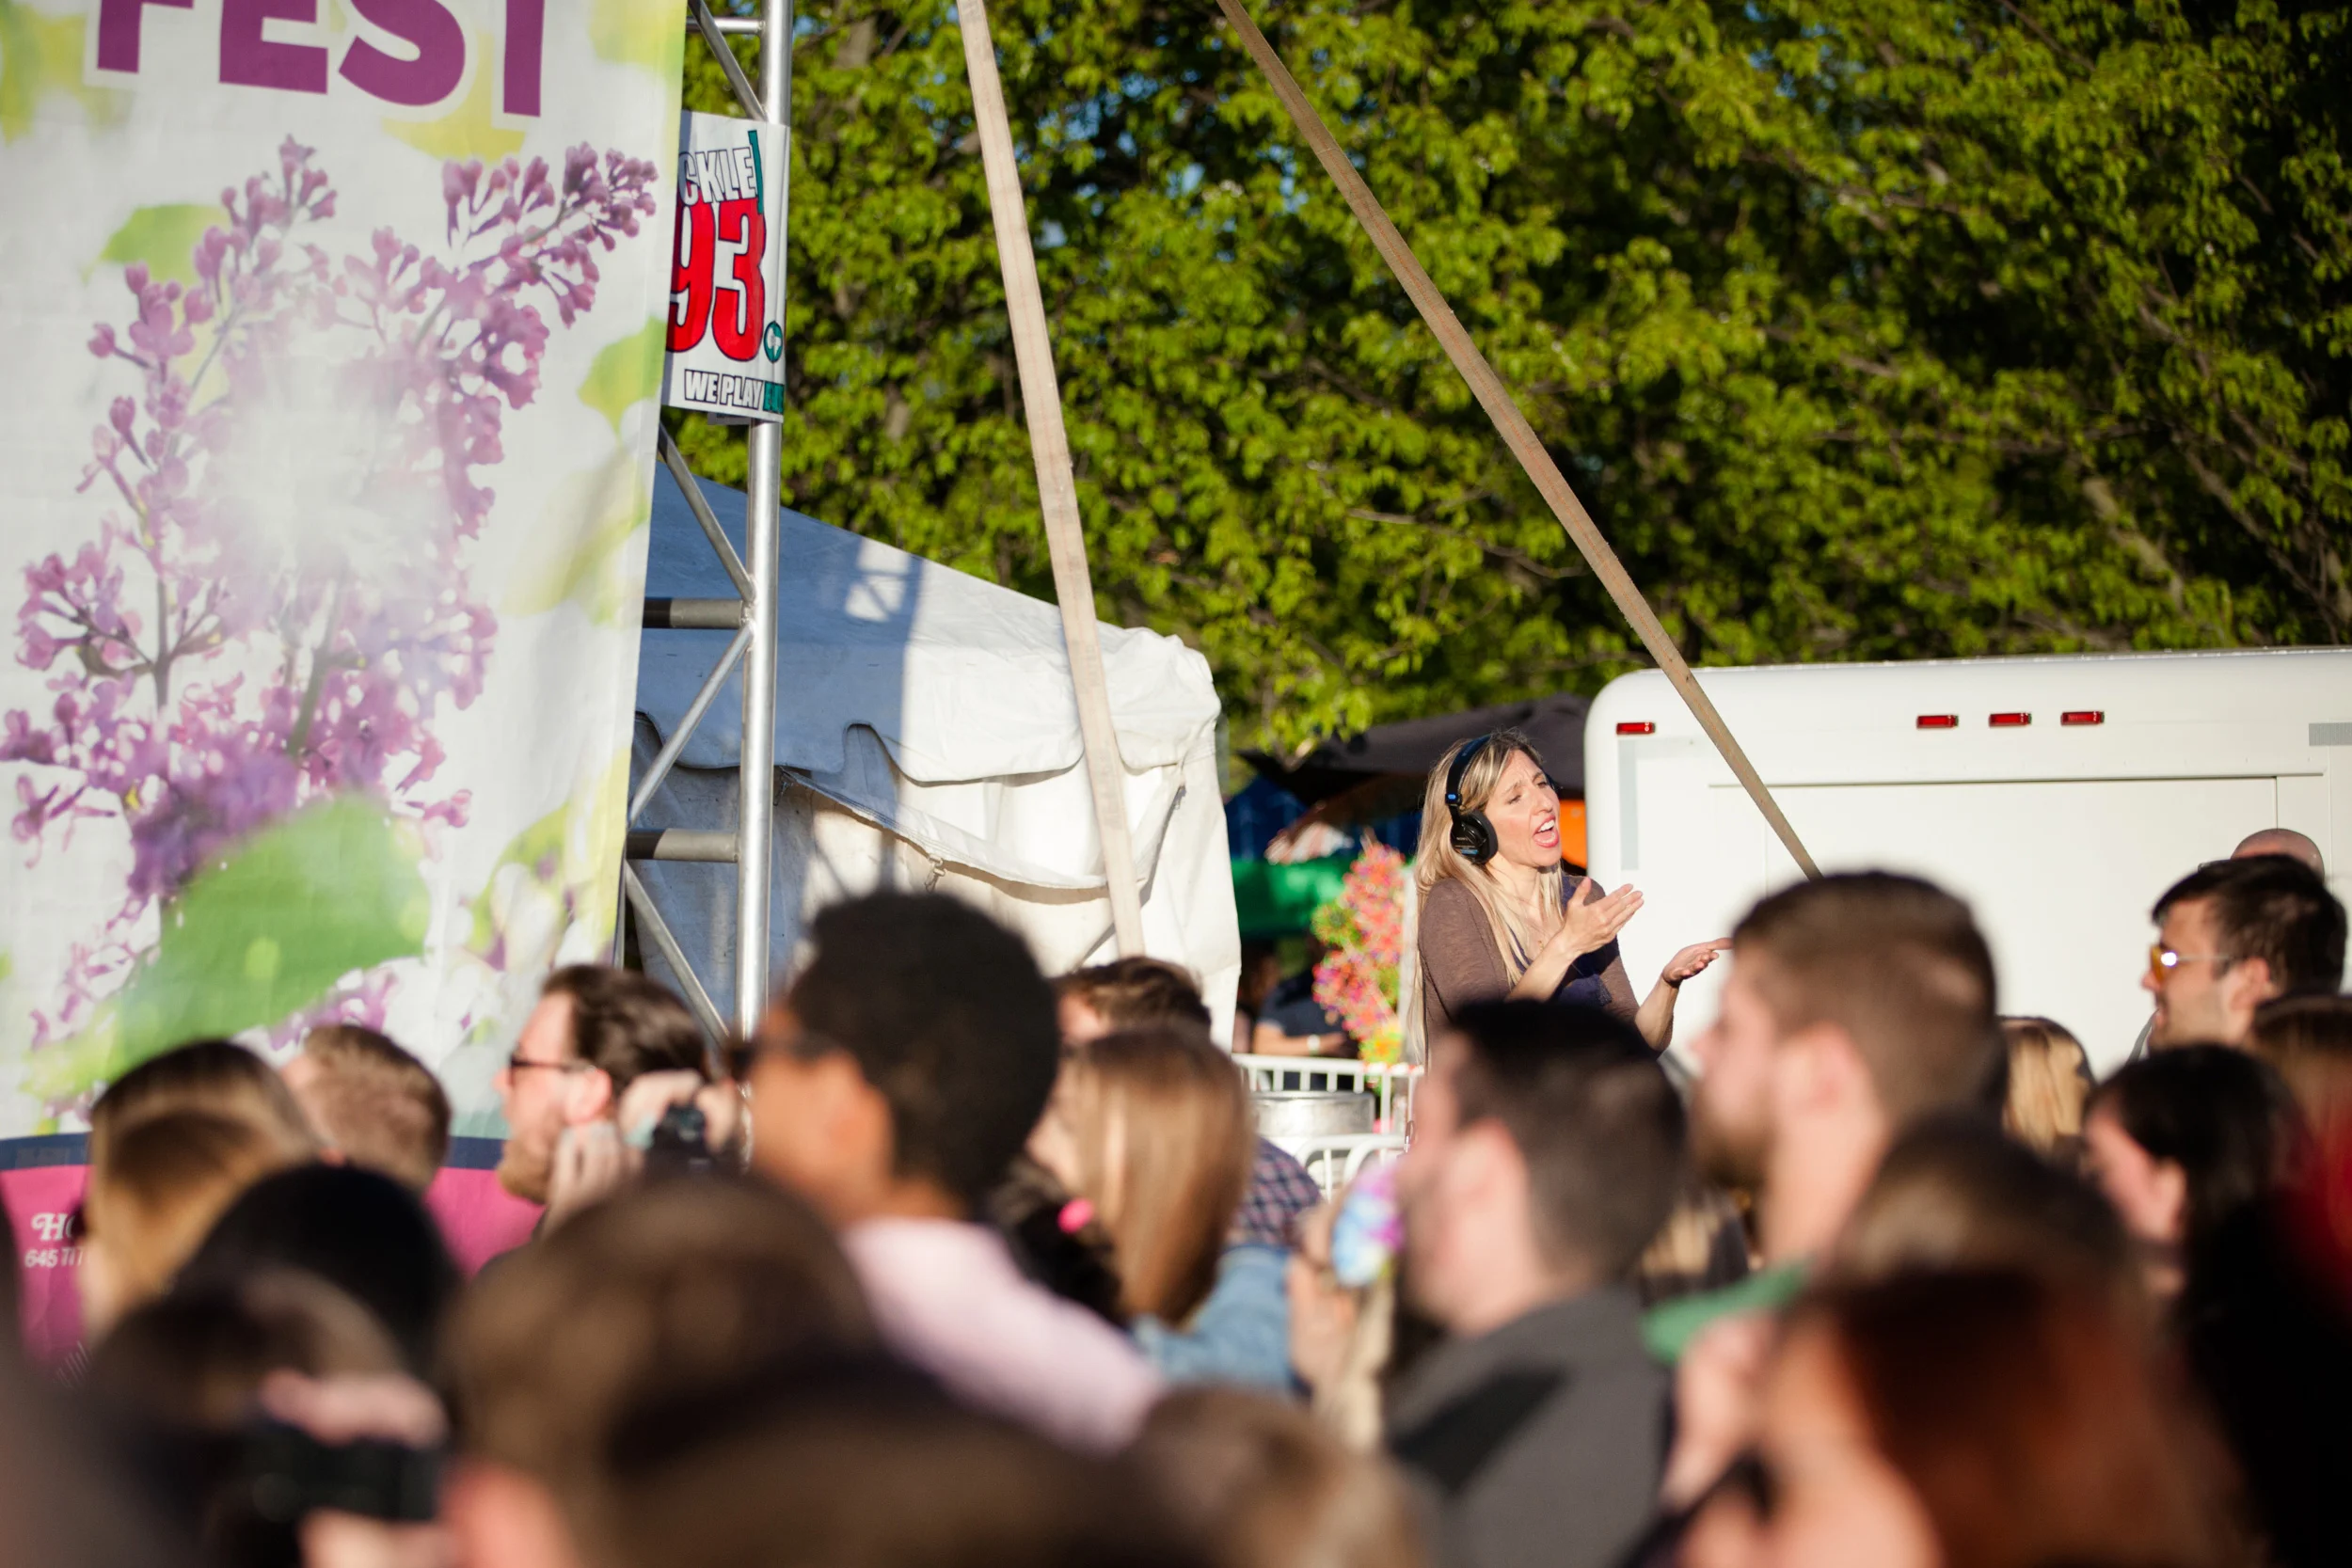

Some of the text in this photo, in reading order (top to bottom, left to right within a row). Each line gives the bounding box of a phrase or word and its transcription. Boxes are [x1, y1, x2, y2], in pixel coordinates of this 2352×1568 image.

[684, 369, 720, 404] WE
[719, 373, 764, 410] PLAY
[24, 1248, 58, 1269] 645
